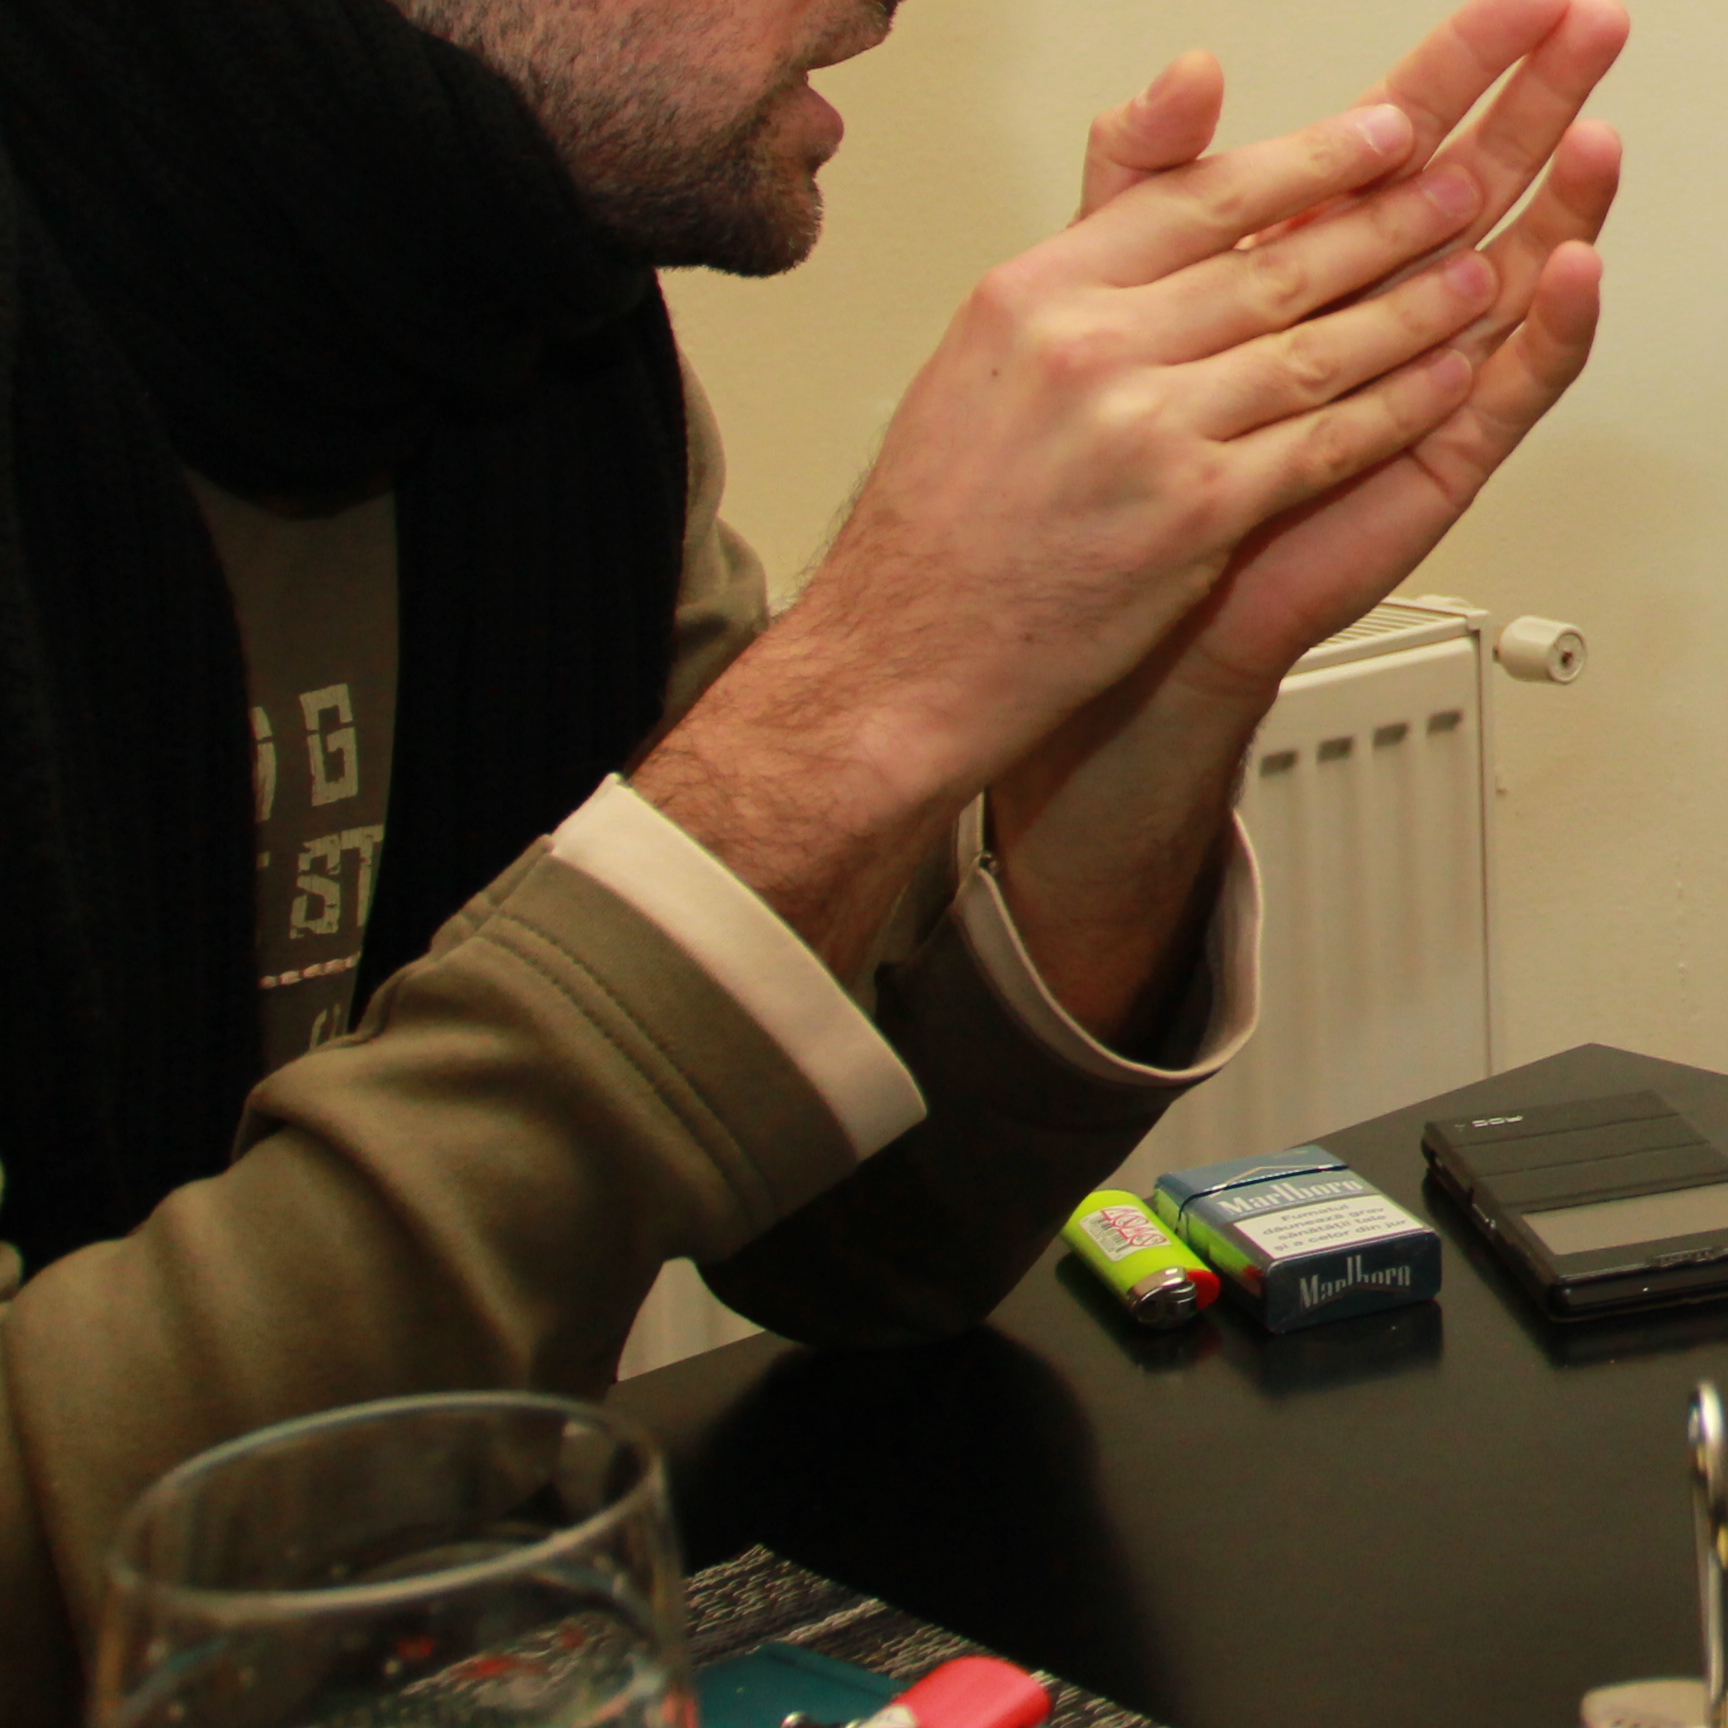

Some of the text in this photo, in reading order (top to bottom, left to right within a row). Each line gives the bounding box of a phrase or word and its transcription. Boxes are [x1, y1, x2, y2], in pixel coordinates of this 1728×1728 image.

[1217, 1178, 1365, 1217] Marlboro
[1281, 1203, 1349, 1221] Fumatul
[1349, 1207, 1385, 1218] grav
[1354, 1214, 1387, 1224] tale
[1292, 1240, 1304, 1248] a
[1308, 1229, 1350, 1243] celor
[1354, 1222, 1382, 1234] din
[1385, 1218, 1407, 1230] jur
[1301, 1254, 1412, 1309] Marlboro
